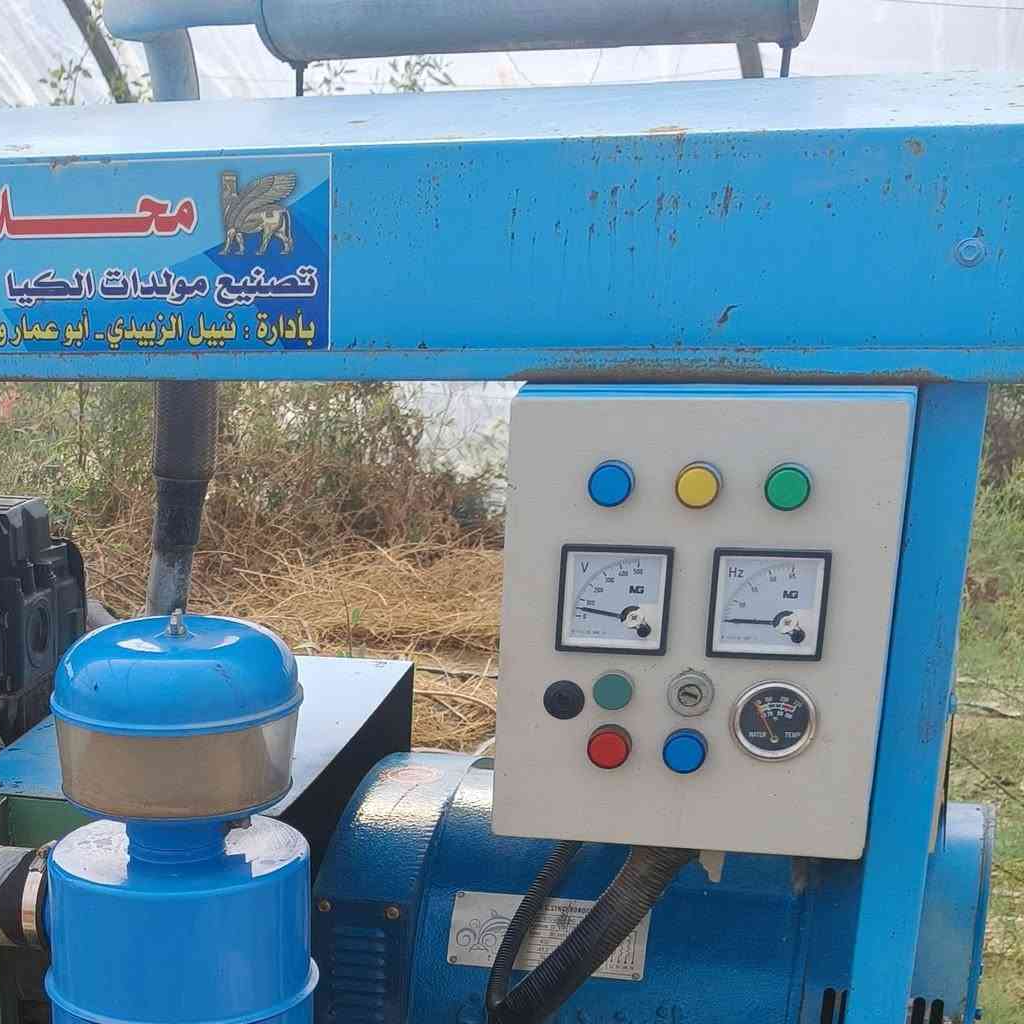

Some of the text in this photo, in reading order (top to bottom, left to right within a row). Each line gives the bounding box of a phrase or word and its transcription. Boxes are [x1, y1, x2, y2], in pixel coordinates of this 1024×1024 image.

[5, 265, 318, 306] تصنيع مولدات الكيا
[12, 314, 60, 348] عمار
[65, 307, 89, 347] أبو
[188, 312, 237, 347] نبيل
[581, 561, 589, 573] V
[728, 566, 745, 578] Hz
